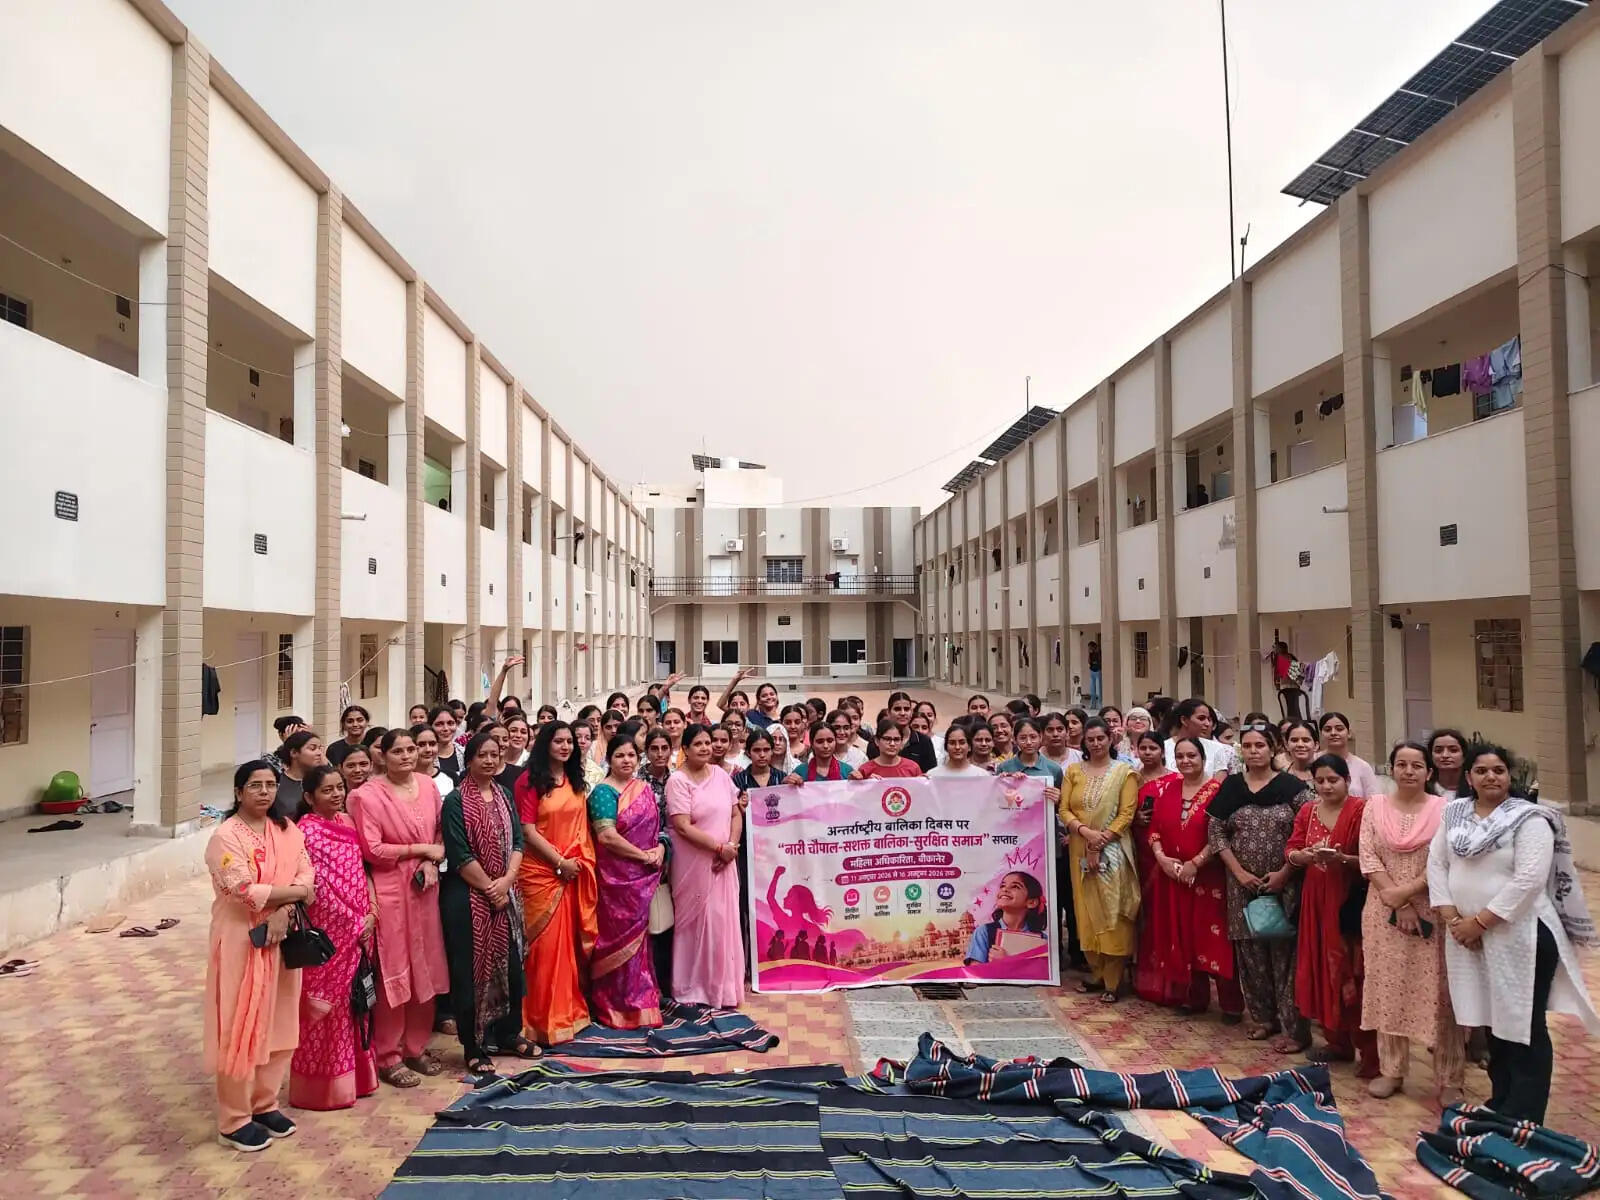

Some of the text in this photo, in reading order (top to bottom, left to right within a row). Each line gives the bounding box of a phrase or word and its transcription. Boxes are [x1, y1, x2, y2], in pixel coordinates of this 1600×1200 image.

[827, 820, 882, 837] अन्तर्राष्ट्रीय
[885, 818, 923, 831] बालिका
[956, 820, 970, 830] पर
[778, 839, 805, 856] “नारी
[874, 832, 948, 850] बालिका-सुरक्षित
[952, 833, 989, 847] समाज”
[992, 835, 1018, 845] सप्ताह
[850, 853, 945, 868] महिला अधिकारिता, बीकानेर
